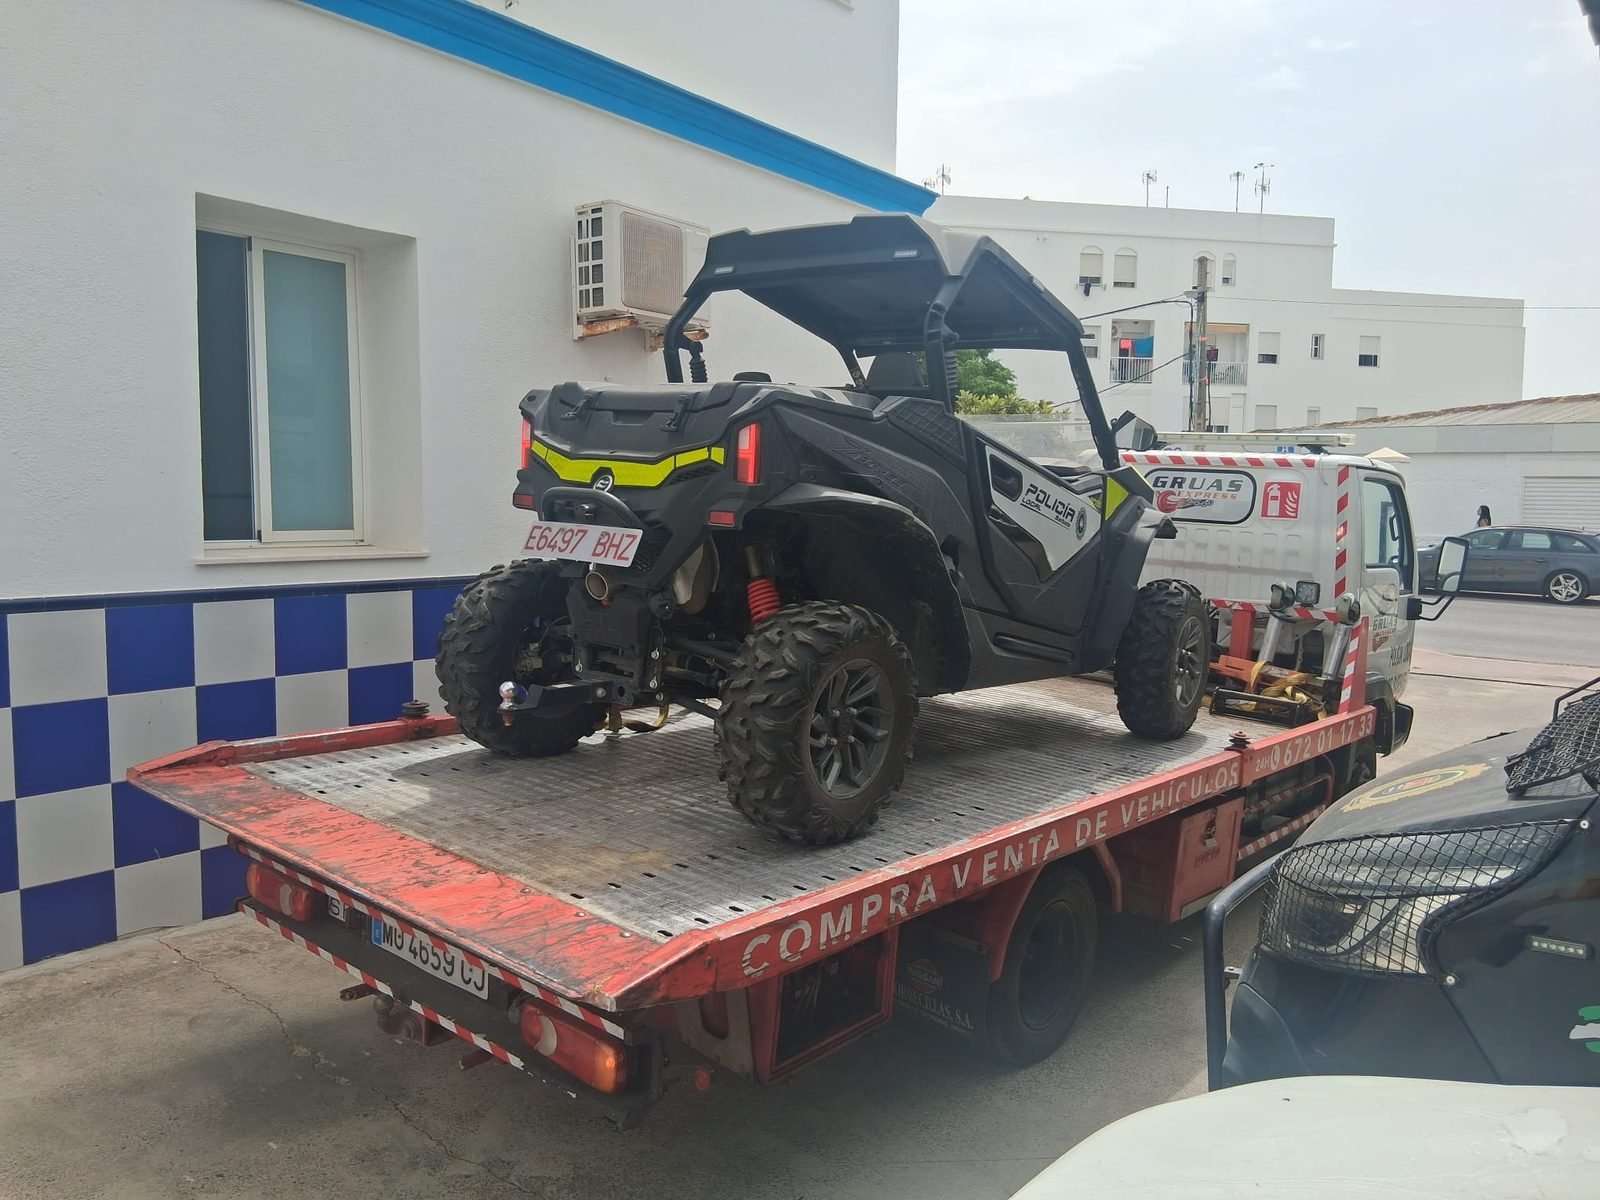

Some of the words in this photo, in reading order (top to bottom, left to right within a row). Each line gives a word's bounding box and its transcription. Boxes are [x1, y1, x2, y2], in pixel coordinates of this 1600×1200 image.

[1025, 483, 1076, 522] POLICÍA
[1152, 476, 1244, 492] GRUAS
[1177, 490, 1237, 500] EXPRESS
[524, 525, 588, 554] E6497
[592, 530, 638, 561] BHZ
[1284, 735, 1312, 765] 672
[1317, 728, 1333, 753] 01
[1341, 719, 1355, 744] 17
[1359, 713, 1374, 737] 33
[742, 874, 937, 978] COMPRA
[952, 828, 1060, 890] VENTA
[1075, 810, 1109, 848] DE
[409, 935, 455, 977] 4659
